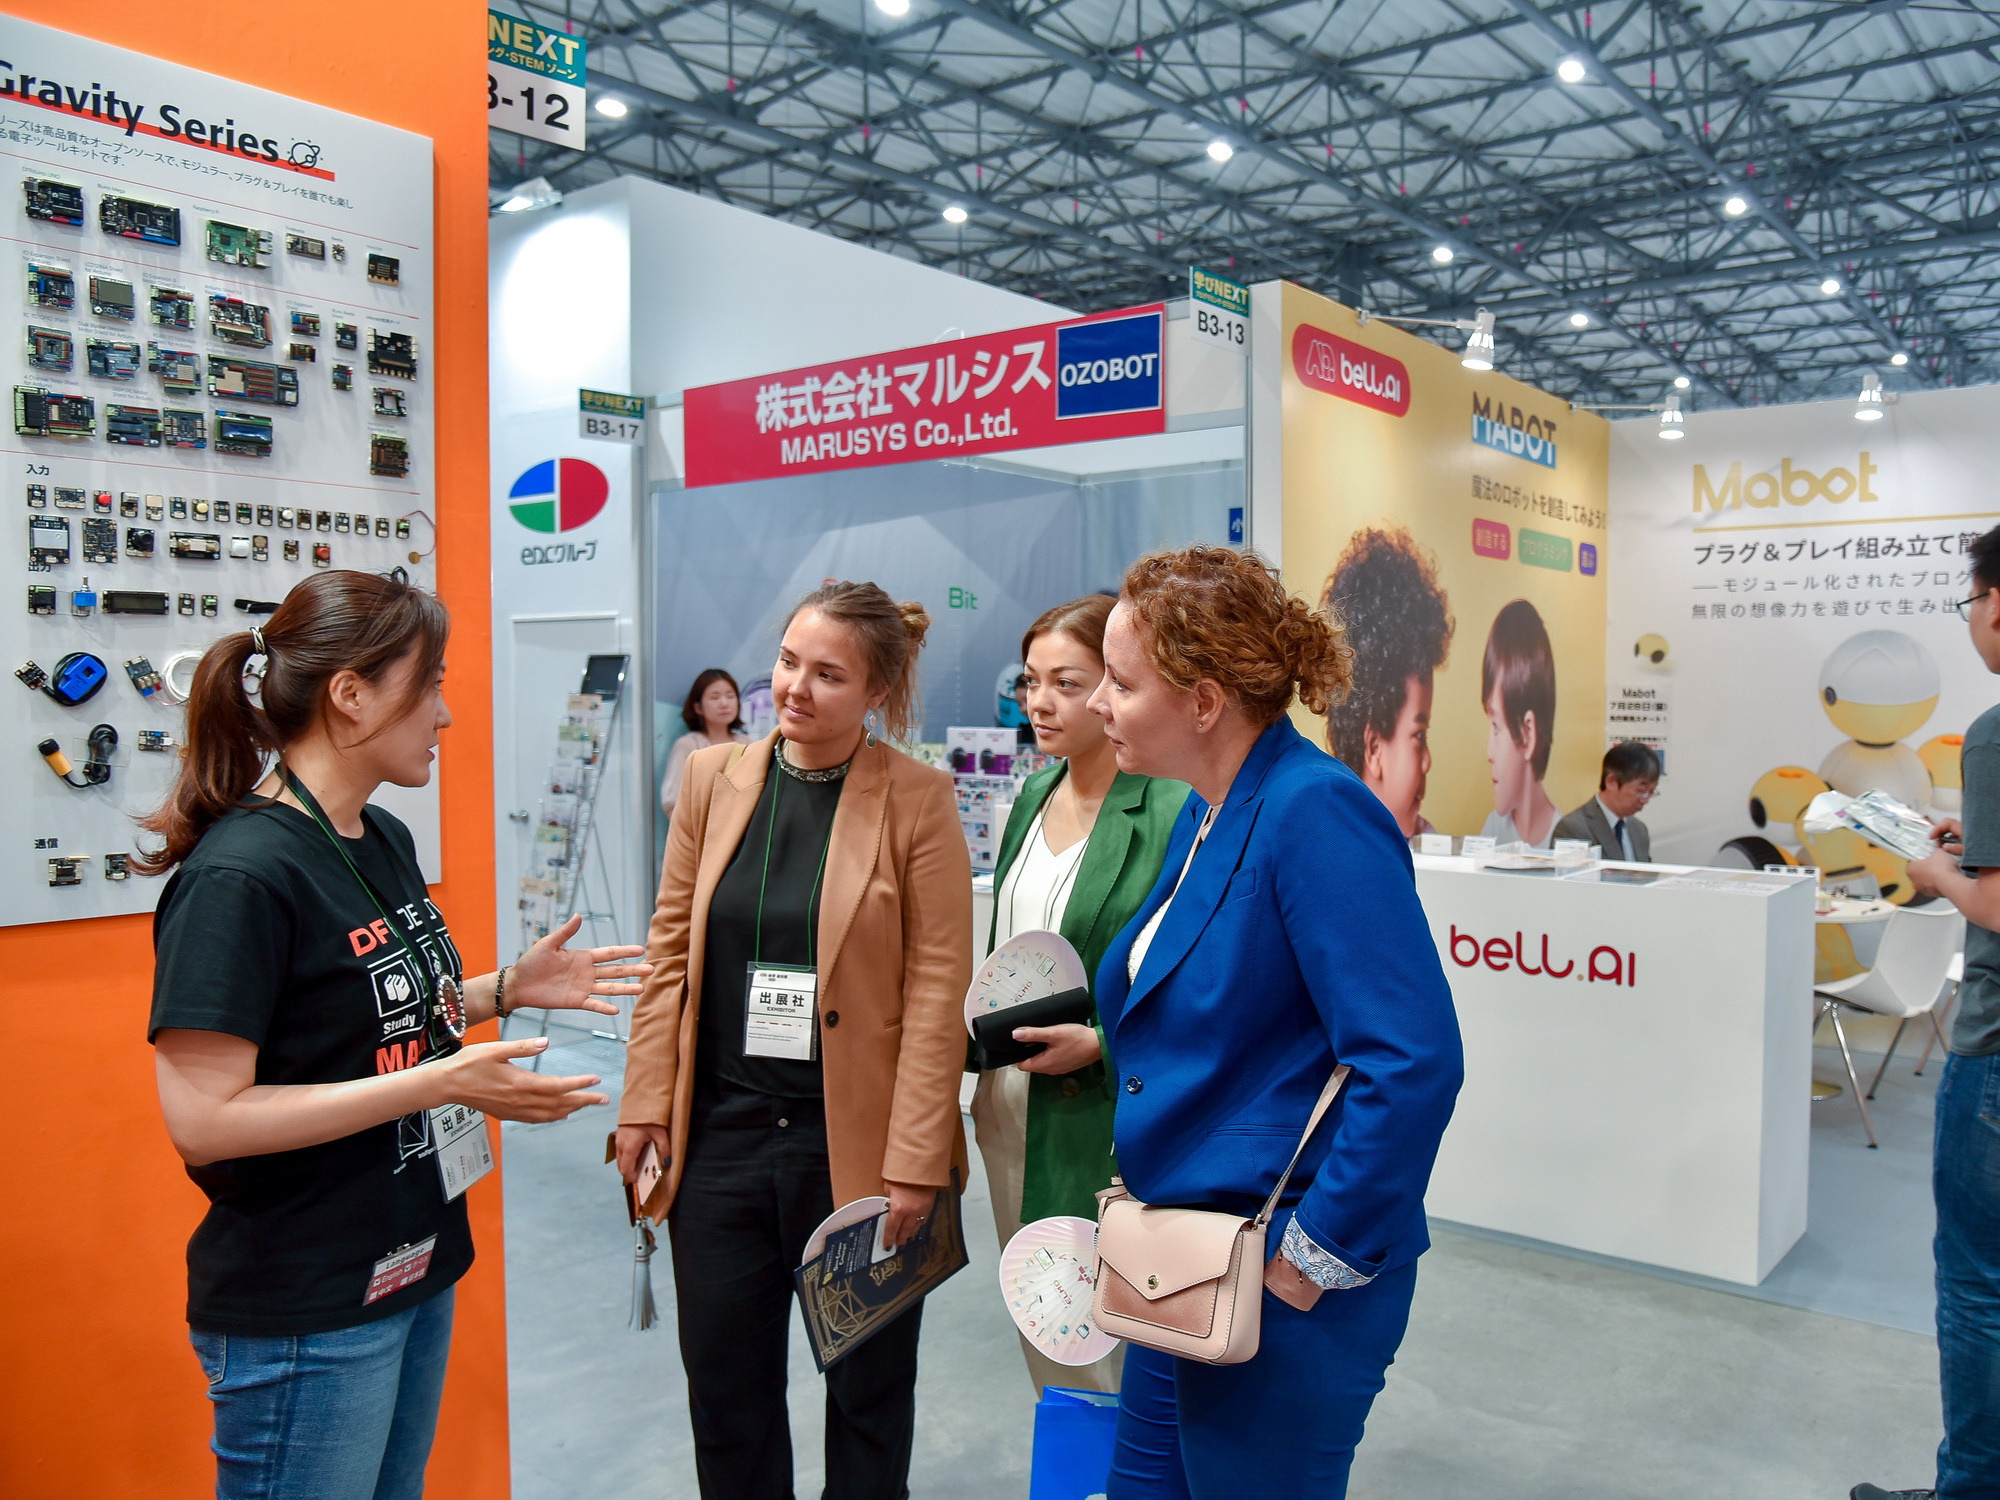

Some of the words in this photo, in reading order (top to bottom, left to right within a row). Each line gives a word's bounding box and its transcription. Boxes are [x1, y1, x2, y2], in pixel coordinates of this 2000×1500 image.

[488, 14, 580, 66] NEXT
[159, 104, 279, 162] Series
[1198, 310, 1244, 345] B3-13
[755, 340, 1052, 434] 株式会社マルシス
[1060, 352, 1158, 388] OZOBOT
[586, 418, 640, 440] B3-17
[781, 423, 906, 465] MARUSYS
[914, 408, 1018, 447] Co.,Ltd.
[26, 463, 50, 476] 入力
[1692, 451, 1879, 513] Mabot
[948, 587, 979, 611] Bit
[759, 991, 805, 1007] 出展社
[383, 1013, 416, 1035] Study
[376, 1036, 427, 1075] MA
